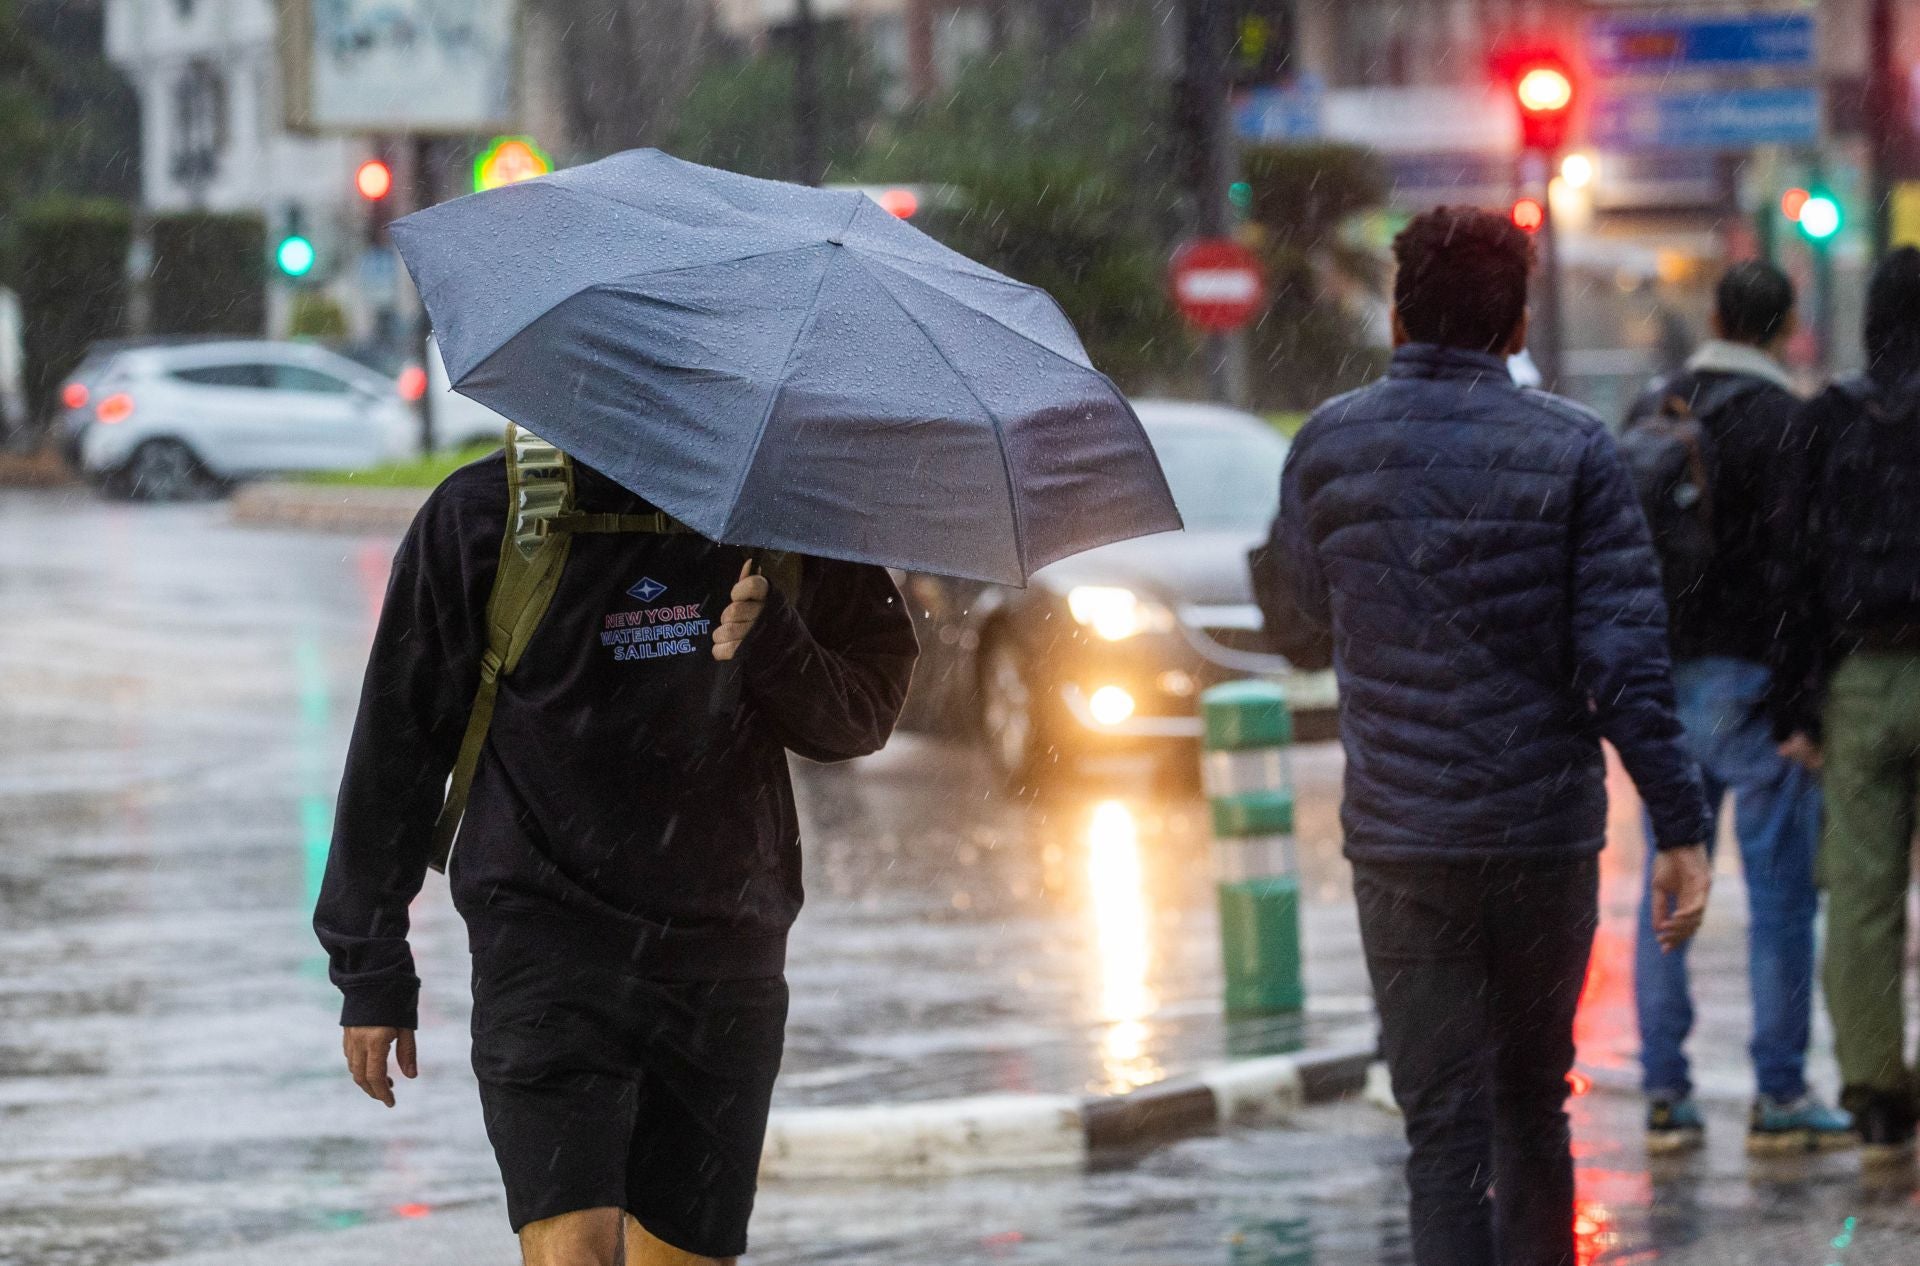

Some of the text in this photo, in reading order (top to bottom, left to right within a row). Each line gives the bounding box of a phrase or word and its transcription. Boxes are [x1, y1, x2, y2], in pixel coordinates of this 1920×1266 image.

[605, 603, 701, 629] NEW YORK
[600, 620, 710, 646] WATERFRONT
[614, 639, 697, 661] SAILING.
